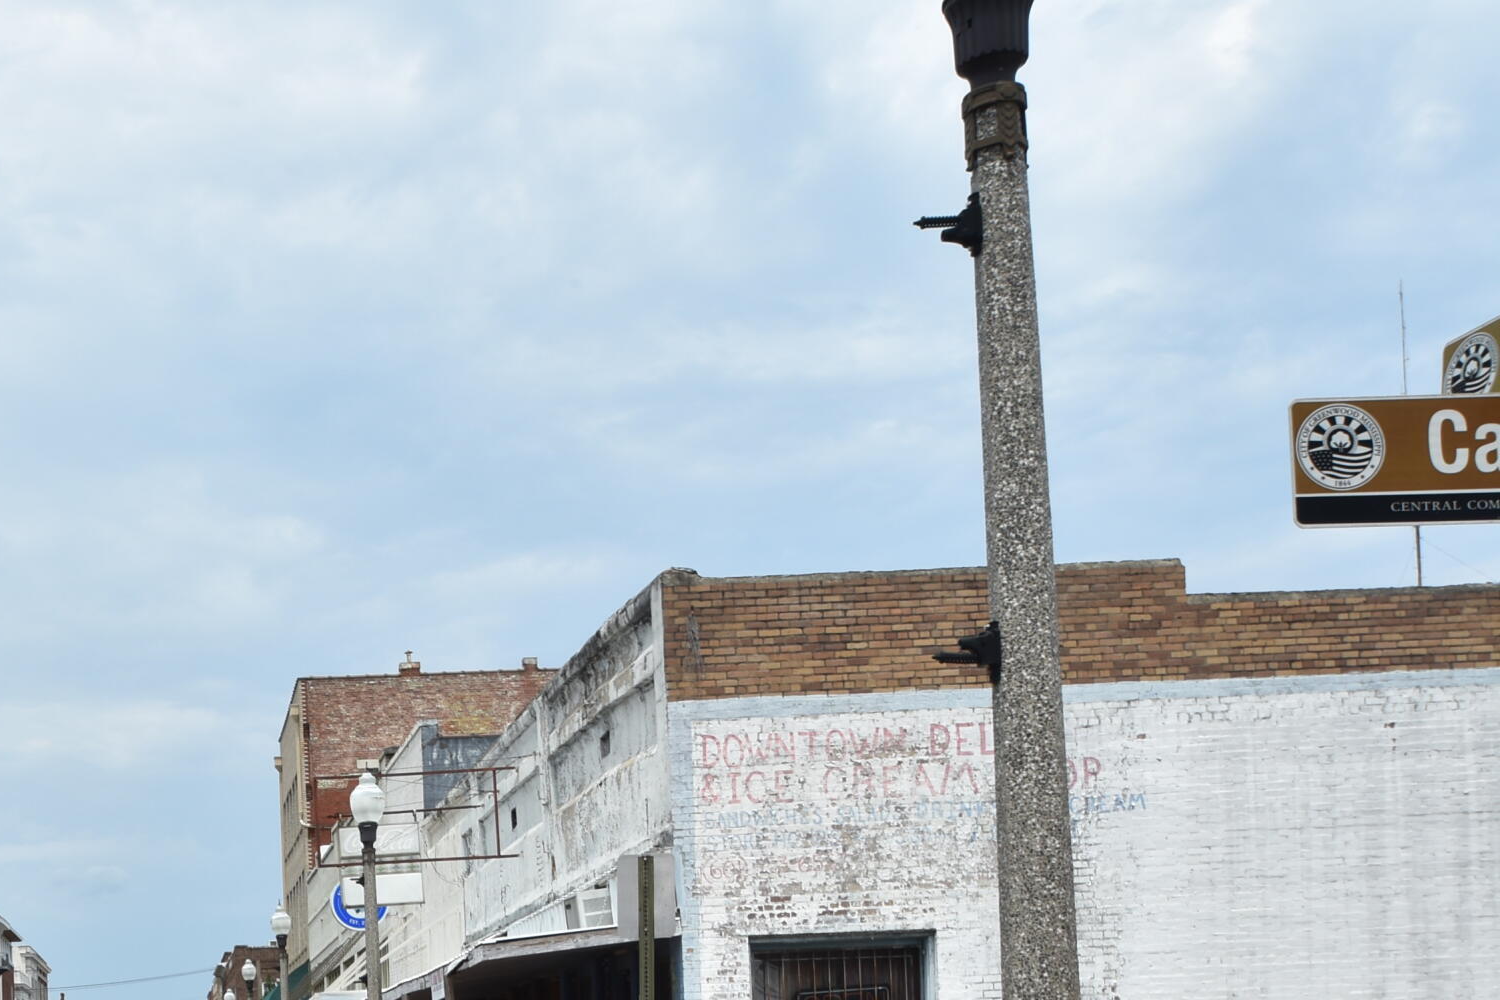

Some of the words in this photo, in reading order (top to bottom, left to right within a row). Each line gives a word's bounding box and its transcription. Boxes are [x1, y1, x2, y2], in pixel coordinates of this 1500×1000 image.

[1428, 409, 1500, 474] Ca
[1390, 500, 1461, 512] CENTRAL
[700, 726, 906, 768] DOWNTOWN
[930, 722, 996, 756] DEL
[915, 799, 997, 821] DRINK
